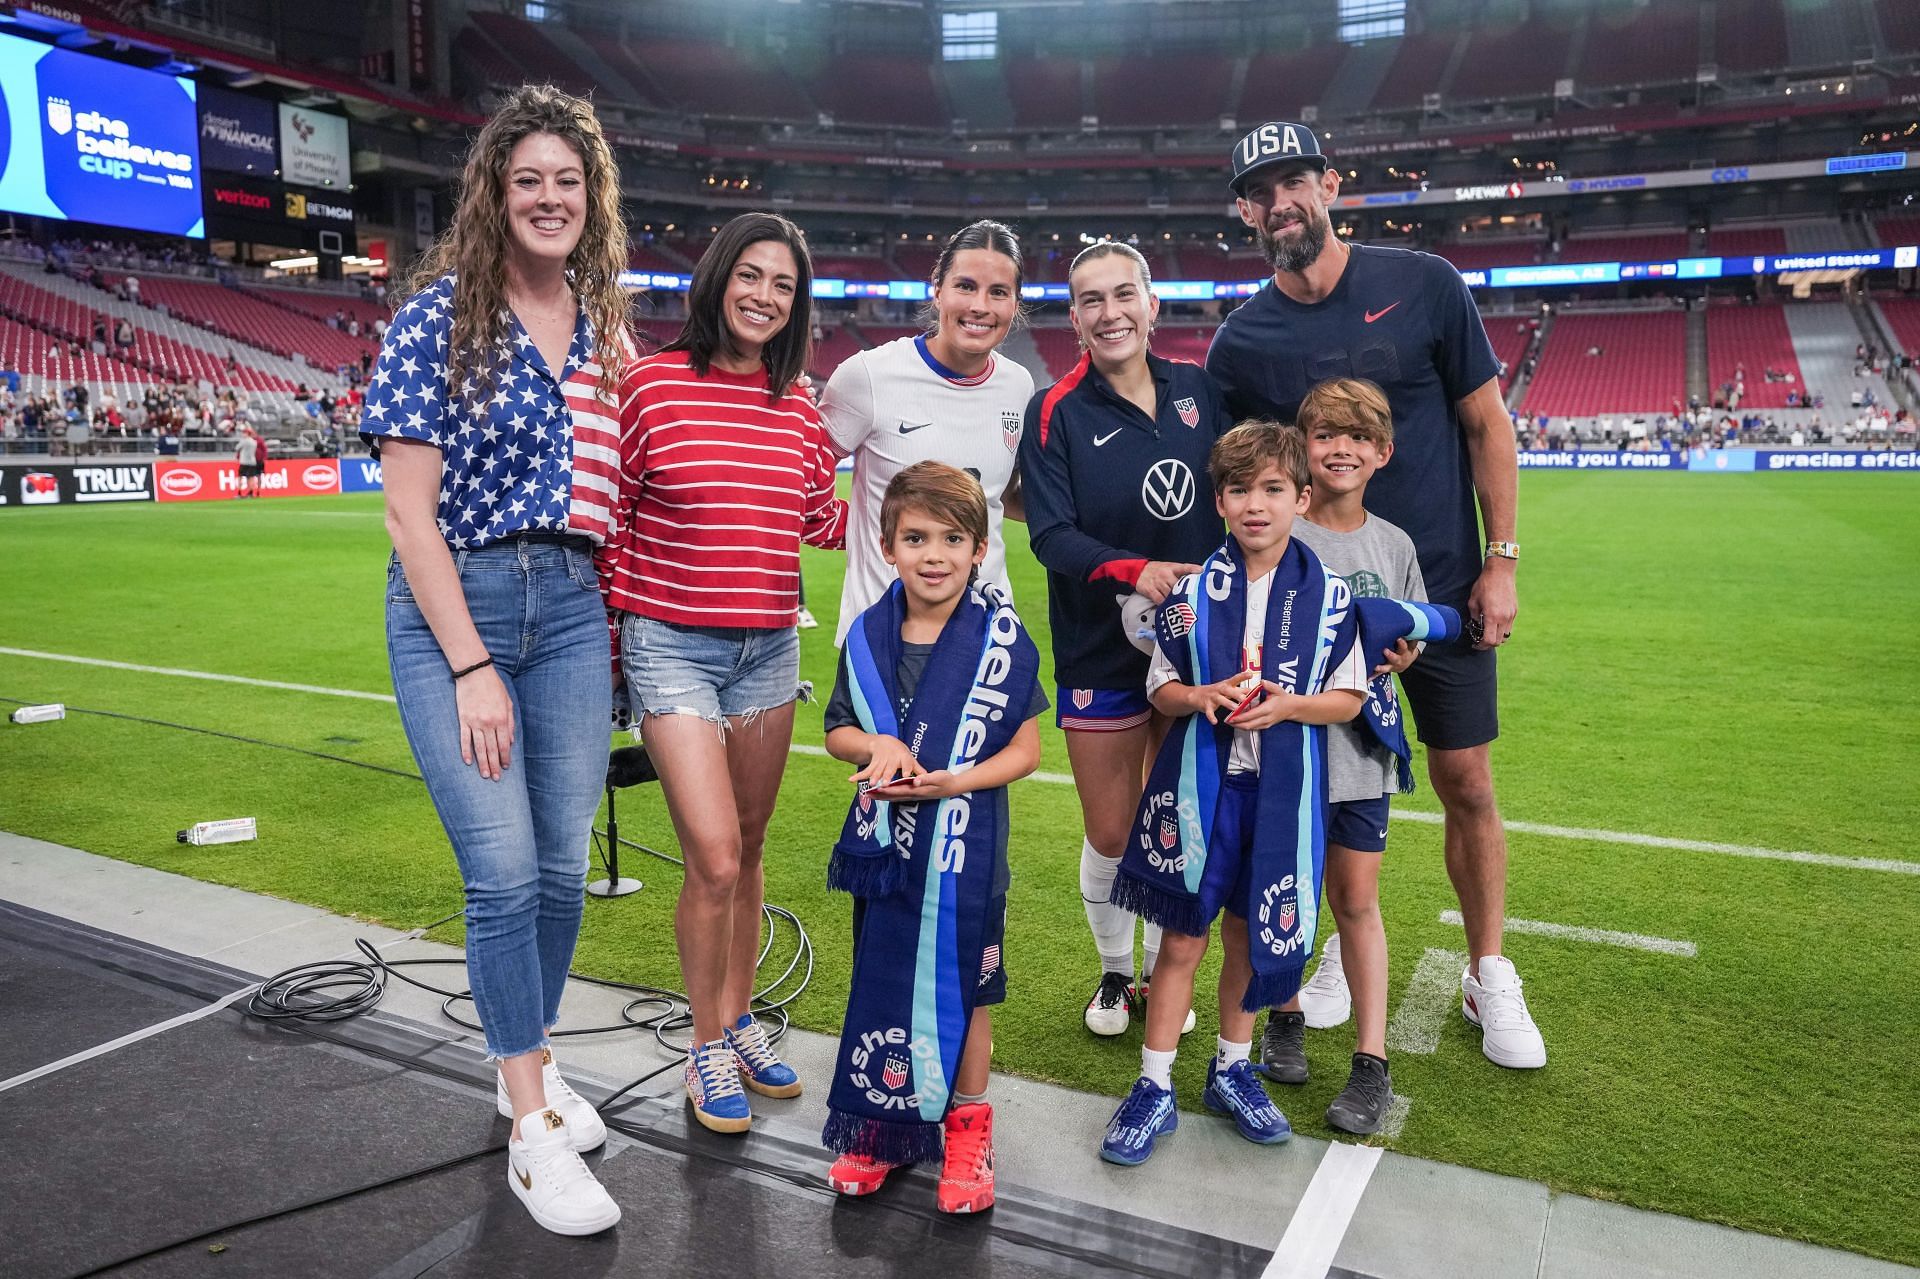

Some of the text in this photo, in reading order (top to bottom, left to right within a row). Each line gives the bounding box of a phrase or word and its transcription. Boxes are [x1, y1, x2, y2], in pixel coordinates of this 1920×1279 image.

[31, 2, 82, 23] HONOR
[75, 110, 130, 139] she
[76, 130, 192, 171] believes
[291, 145, 337, 165] University
[1242, 124, 1302, 166] USA
[78, 155, 133, 179] cup
[1711, 167, 1749, 183] COX
[1455, 184, 1508, 201] SAFEWAY
[1589, 176, 1646, 189] HYUNDAI
[214, 188, 271, 208] verizon
[306, 201, 353, 220] BETMGM
[1774, 254, 1881, 270] United States
[1175, 398, 1195, 412] USA
[1003, 419, 1019, 434] USA
[1577, 454, 1617, 468] you
[1620, 452, 1671, 467] fans
[1769, 452, 1857, 468] gracias
[72, 466, 148, 493] TRULY
[218, 467, 288, 492] Hekel
[1167, 607, 1185, 636] USA
[1278, 590, 1298, 651] Presented by
[1278, 654, 1299, 695] VIS
[1142, 790, 1174, 831] she
[1140, 799, 1206, 874] believes
[1161, 819, 1177, 834] USA
[1258, 874, 1295, 925] she
[1281, 902, 1296, 915] USA
[851, 1026, 907, 1071] she
[849, 1035, 944, 1110] believes
[887, 1057, 909, 1076] USA
